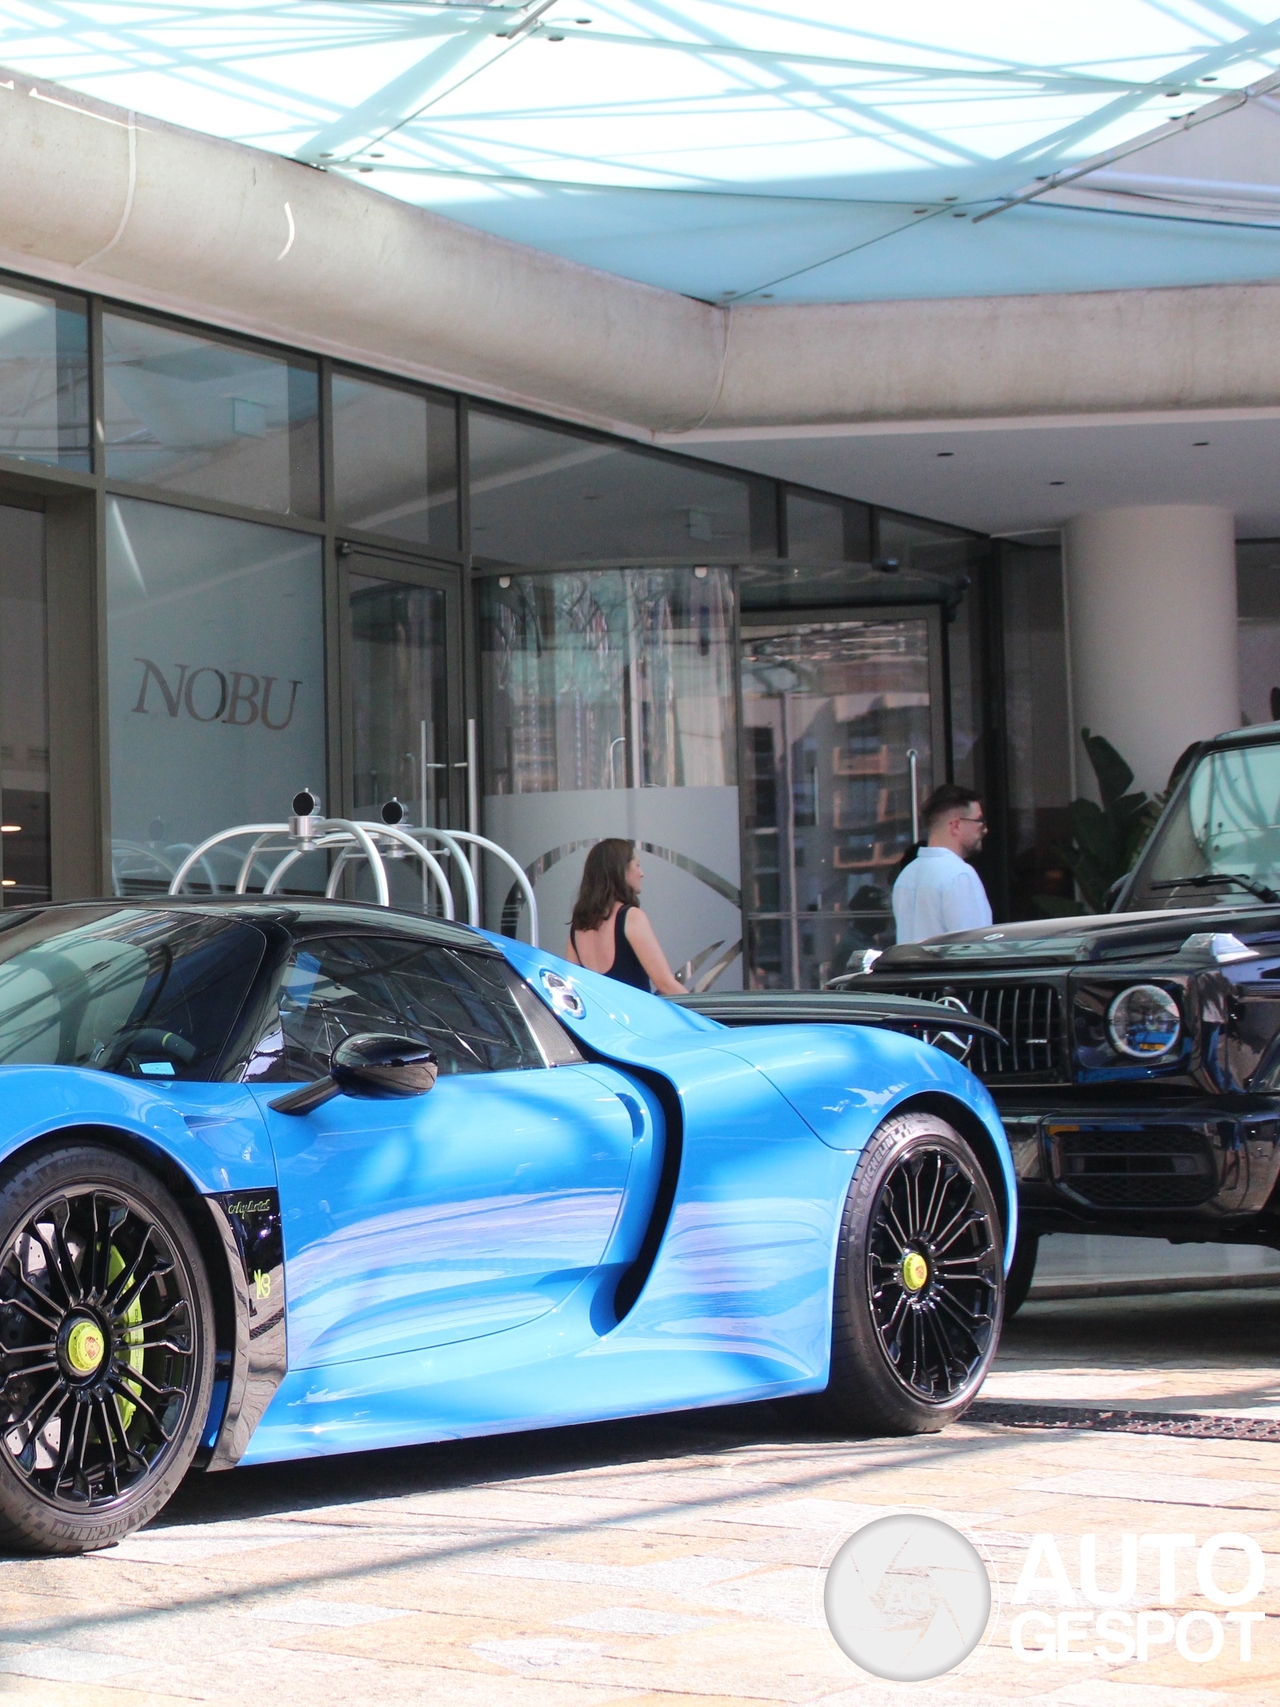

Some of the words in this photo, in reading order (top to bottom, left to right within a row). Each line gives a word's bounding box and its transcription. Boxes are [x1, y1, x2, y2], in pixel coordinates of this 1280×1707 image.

[131, 658, 303, 730] NOBU
[860, 1134, 896, 1196] MICHELIN
[51, 1516, 130, 1540] MICHELIN
